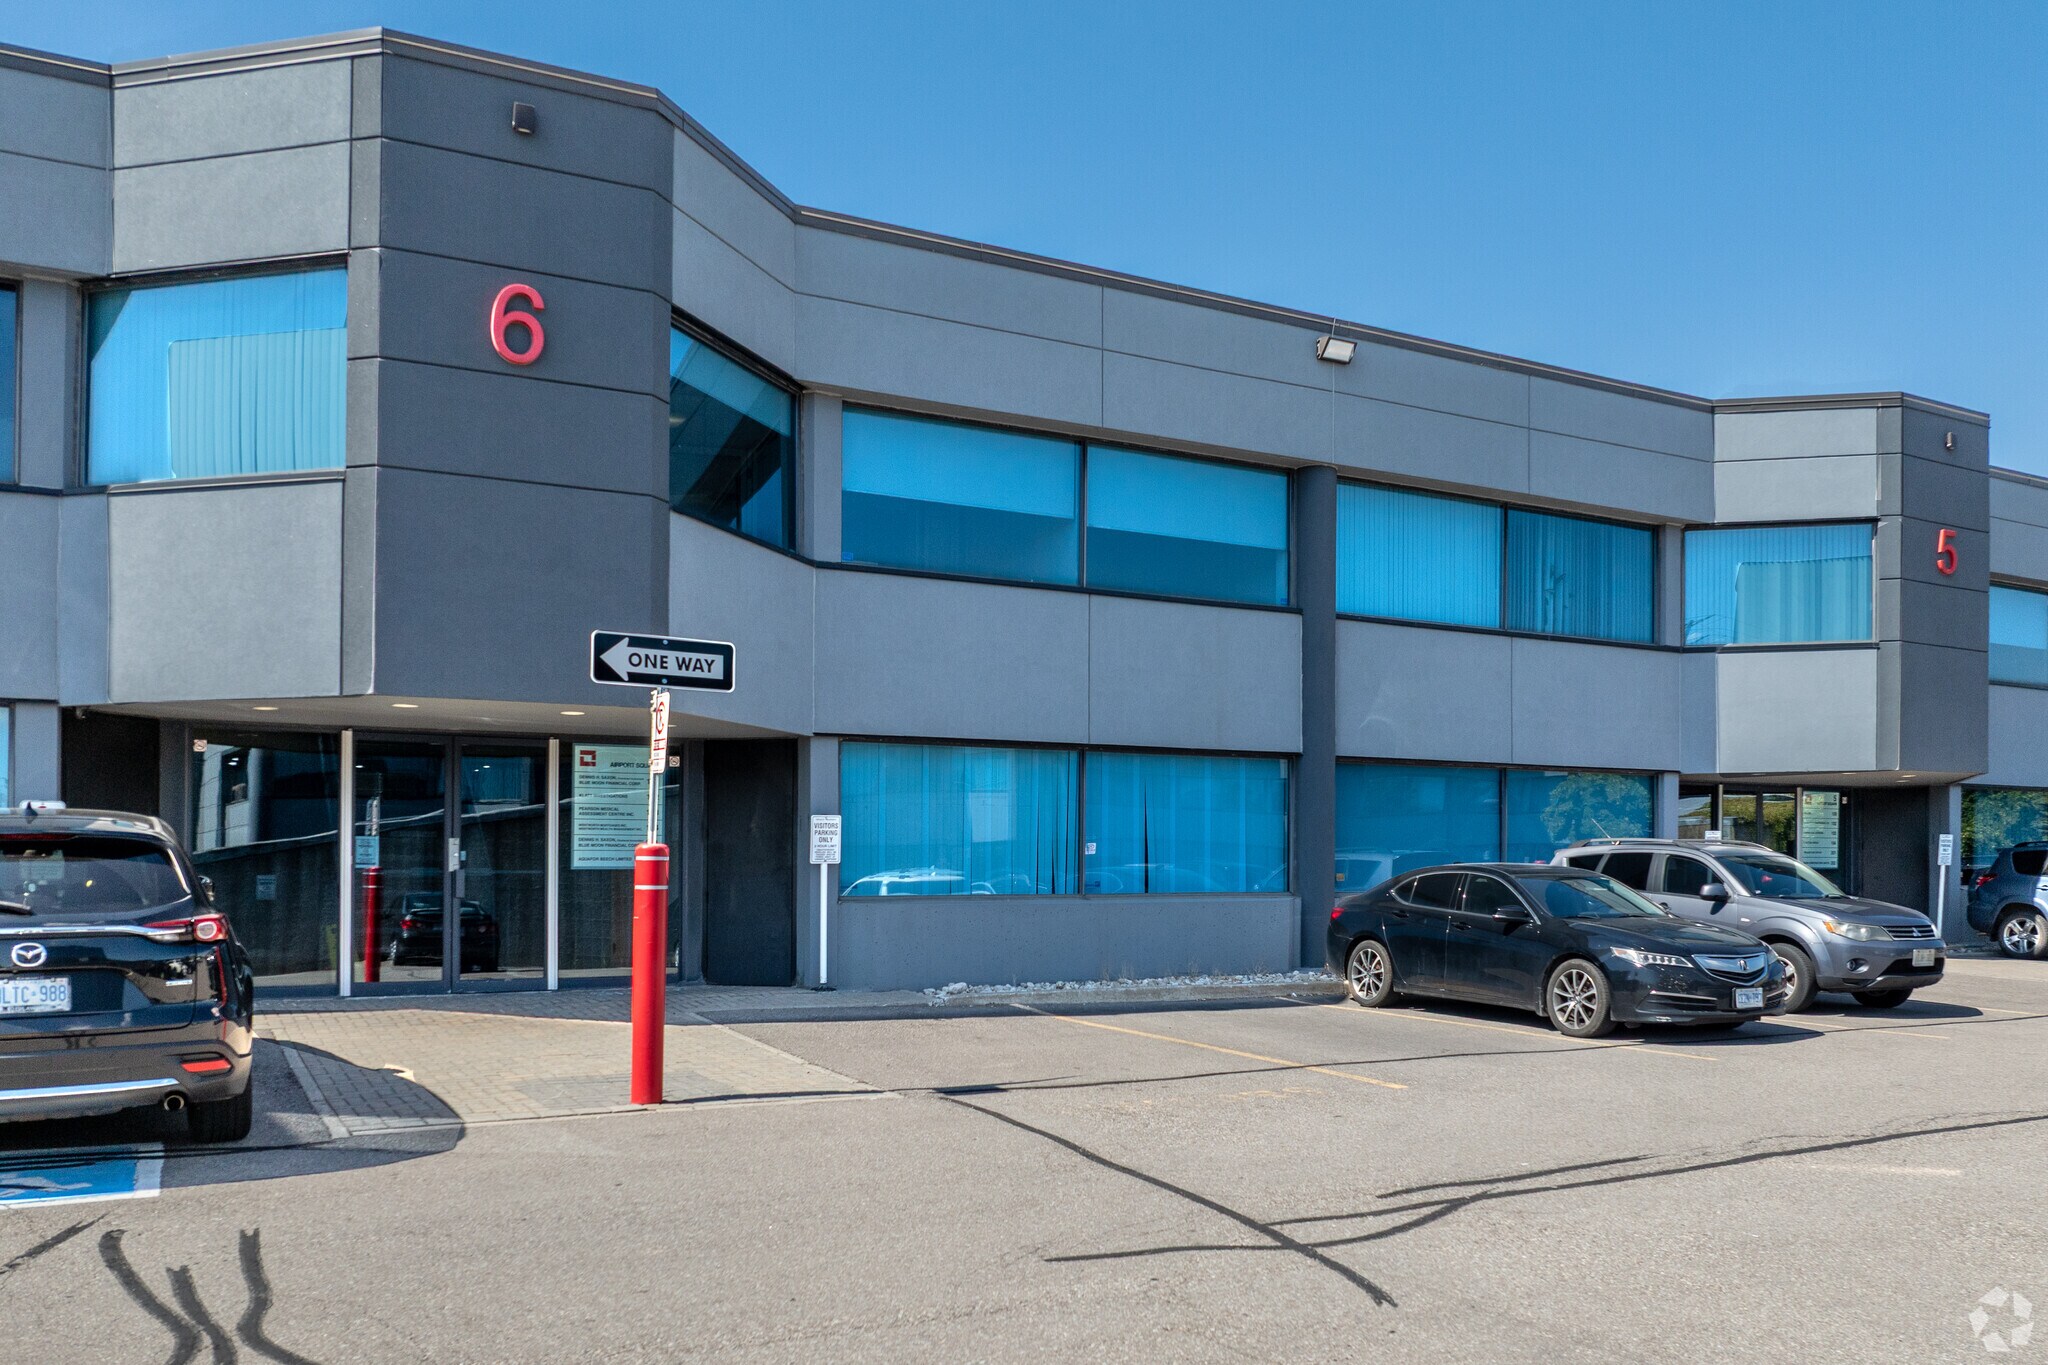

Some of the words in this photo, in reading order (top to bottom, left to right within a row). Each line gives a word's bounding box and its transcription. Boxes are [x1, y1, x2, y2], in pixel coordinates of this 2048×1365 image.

[490, 283, 545, 365] 6
[1937, 528, 1958, 575] 5
[628, 652, 669, 670] ONE
[675, 656, 716, 673] WAY
